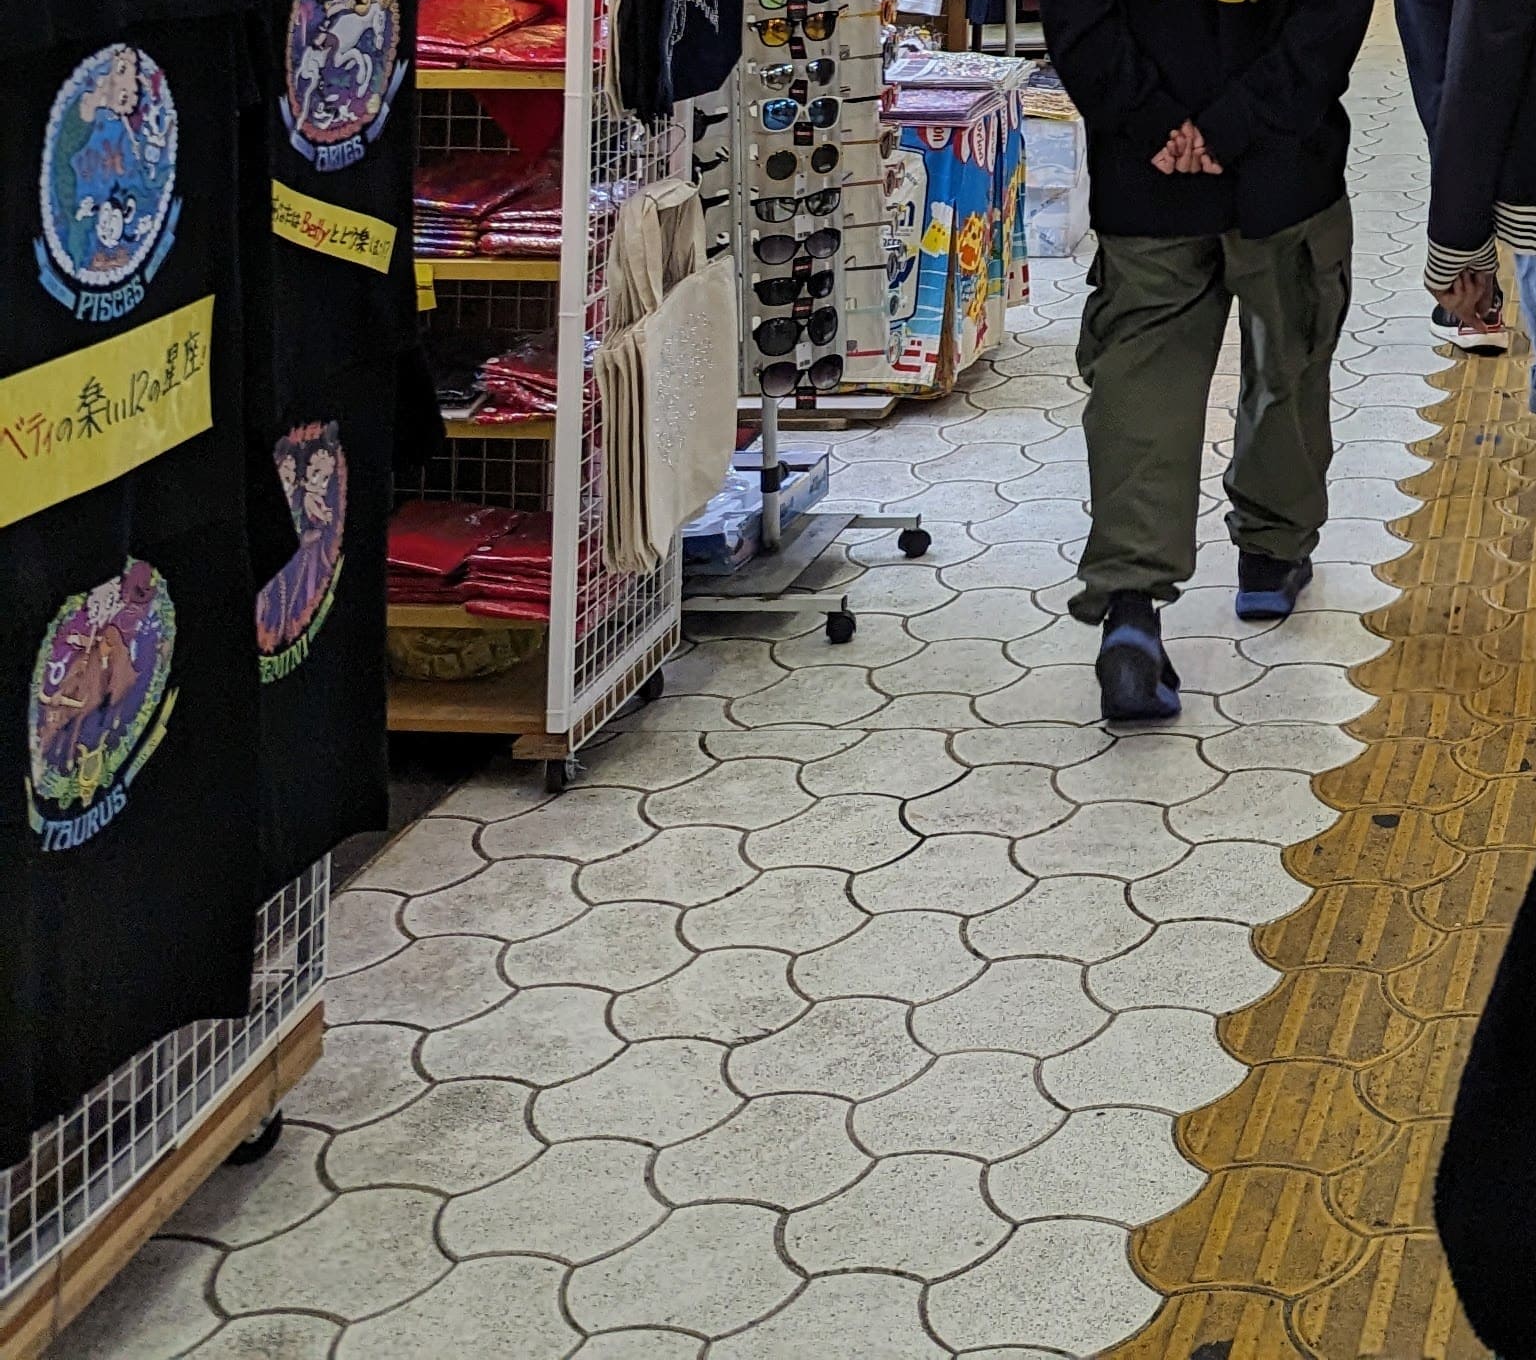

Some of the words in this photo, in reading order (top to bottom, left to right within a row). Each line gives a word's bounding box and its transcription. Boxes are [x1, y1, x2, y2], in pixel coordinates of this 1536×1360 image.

[316, 135, 365, 172] ARIES
[75, 278, 145, 322] PISCES
[258, 634, 310, 683] EMINI
[42, 785, 127, 852] TAURUS
